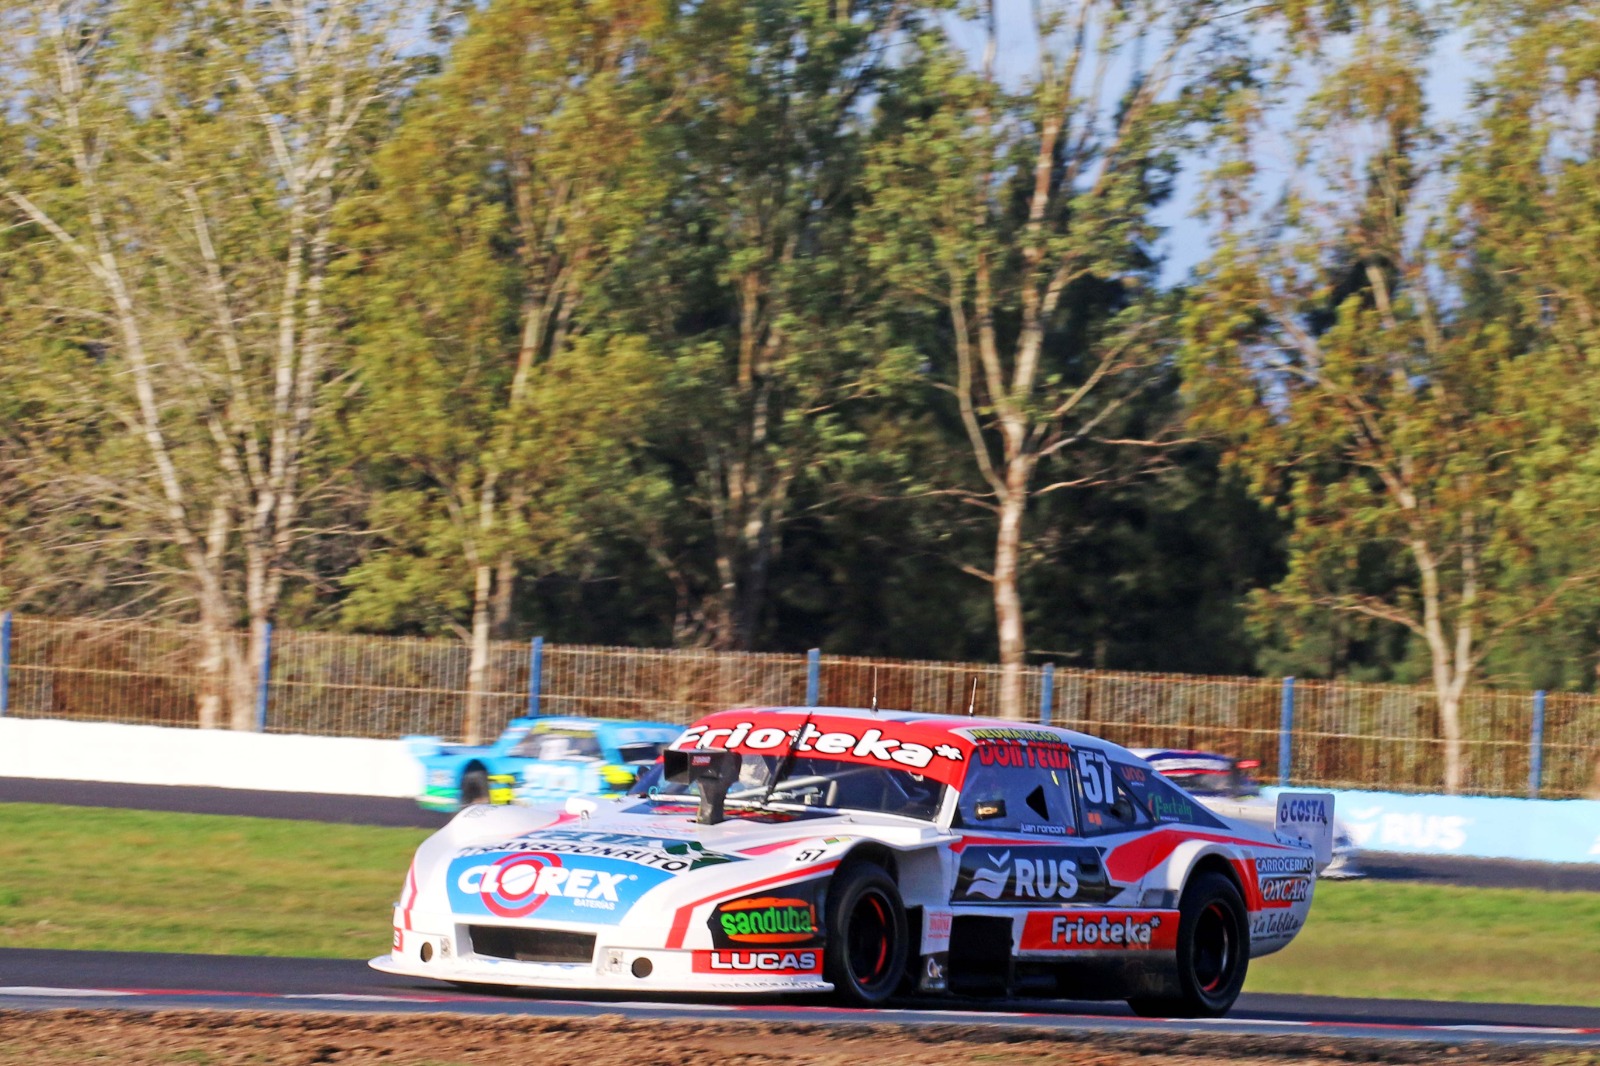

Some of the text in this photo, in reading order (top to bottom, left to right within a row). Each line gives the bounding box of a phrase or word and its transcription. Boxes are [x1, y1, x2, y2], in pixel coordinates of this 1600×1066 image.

[1078, 750, 1114, 804] 57
[1290, 800, 1326, 823] COSTA
[795, 849, 826, 862] 57
[1255, 857, 1313, 872] CARROCERIAS
[458, 863, 627, 903] CLOREX
[1014, 858, 1079, 898] RUS
[710, 952, 816, 970] LUCAS
